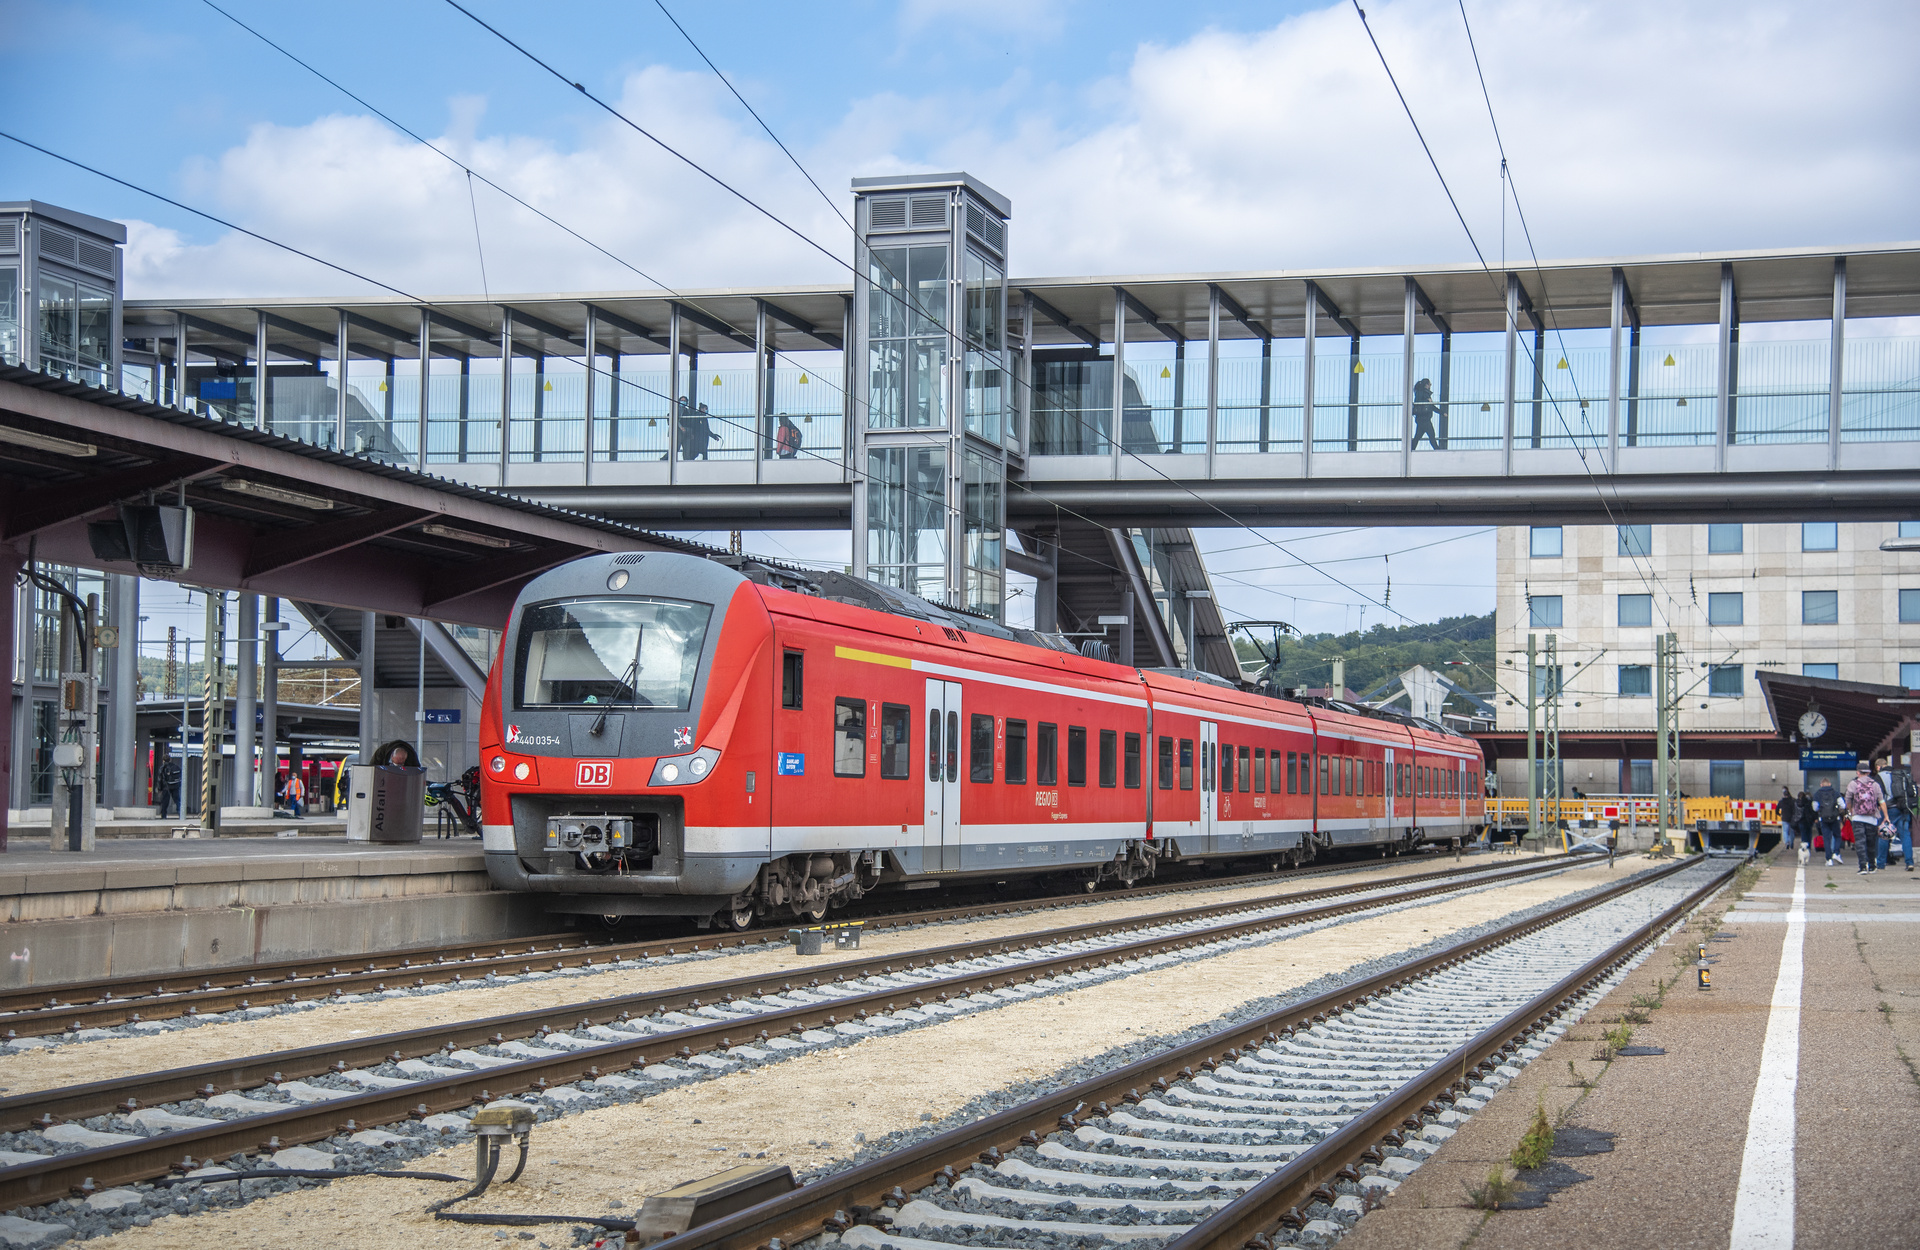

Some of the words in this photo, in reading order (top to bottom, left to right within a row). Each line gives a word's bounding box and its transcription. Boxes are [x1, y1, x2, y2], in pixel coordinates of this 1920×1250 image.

[872, 703, 876, 727] 1
[997, 718, 1003, 739] 2
[520, 736, 534, 745] 440
[536, 736, 560, 745] 035-4
[1174, 739, 1179, 756] 2
[1234, 746, 1238, 761] 2
[579, 764, 609, 785] DB
[1035, 791, 1051, 806] REGIO
[375, 790, 386, 831] Abfall
